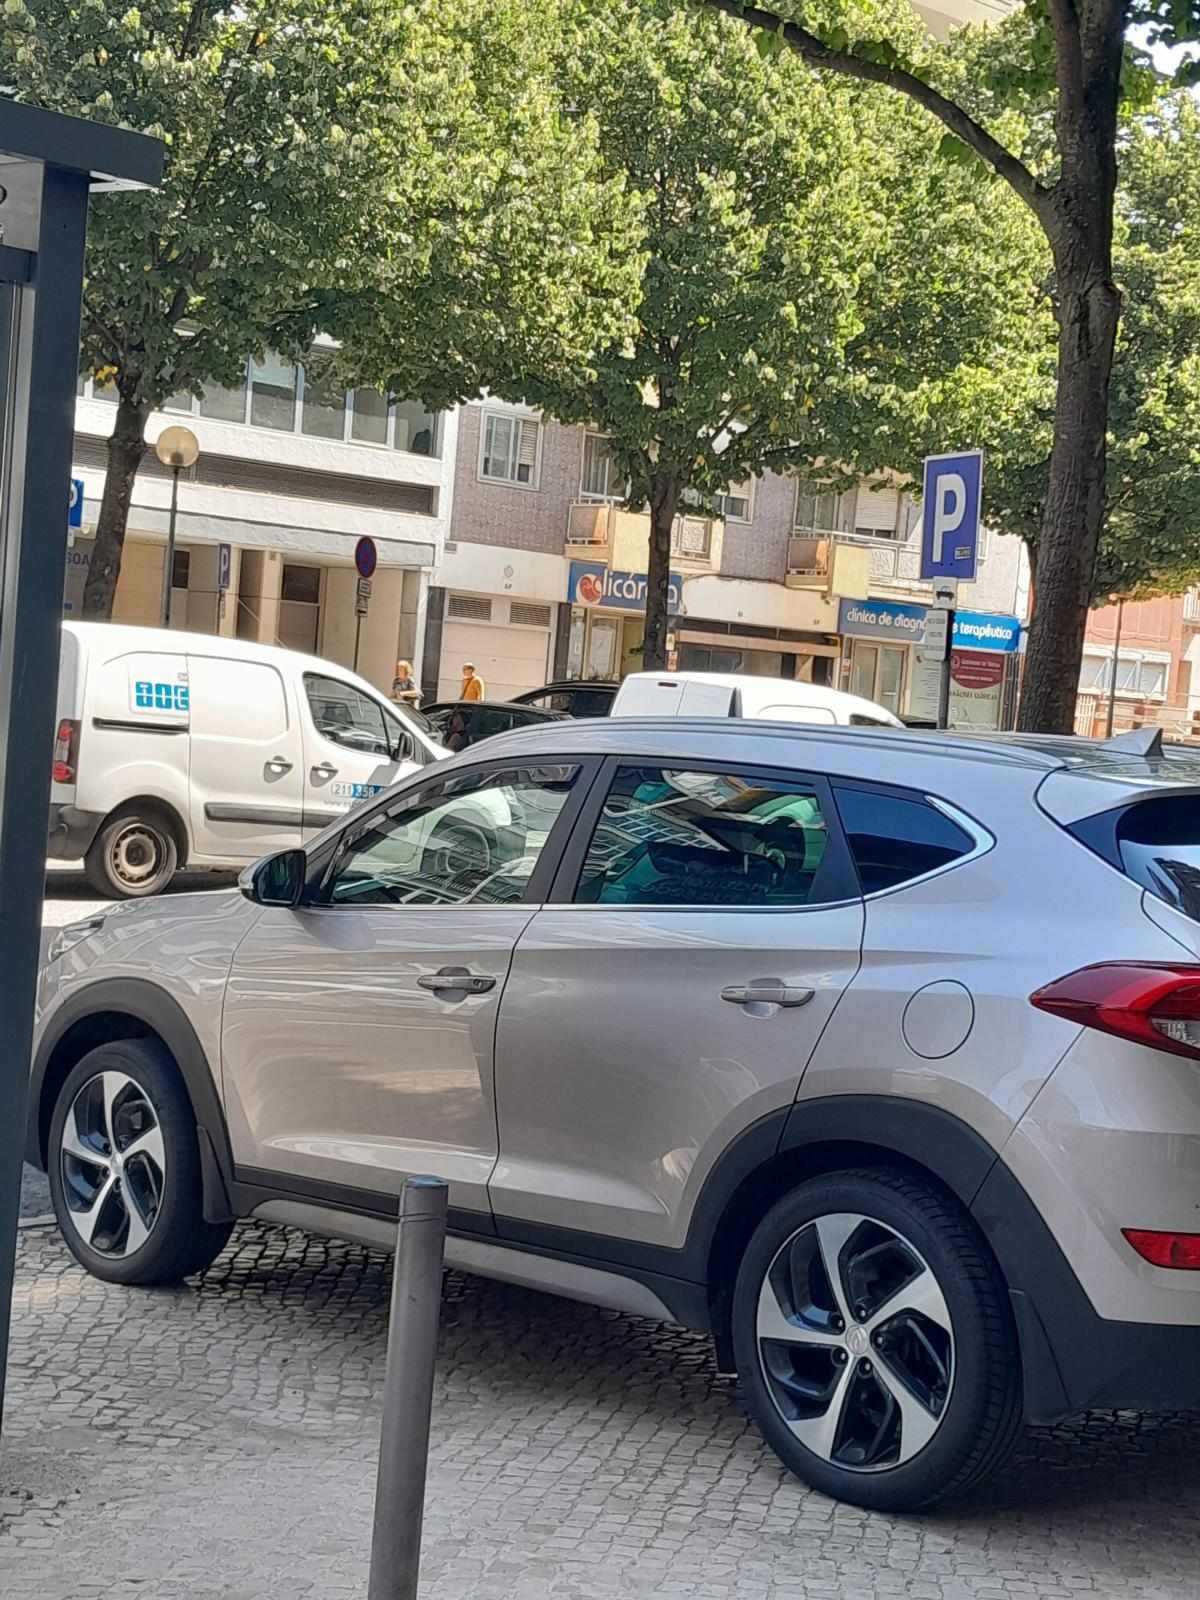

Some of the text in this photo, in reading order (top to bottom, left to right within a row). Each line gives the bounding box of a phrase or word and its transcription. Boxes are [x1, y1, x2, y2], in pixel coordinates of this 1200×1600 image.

[932, 474, 966, 563] P
[847, 607, 876, 624] clínica
[878, 611, 892, 626] de
